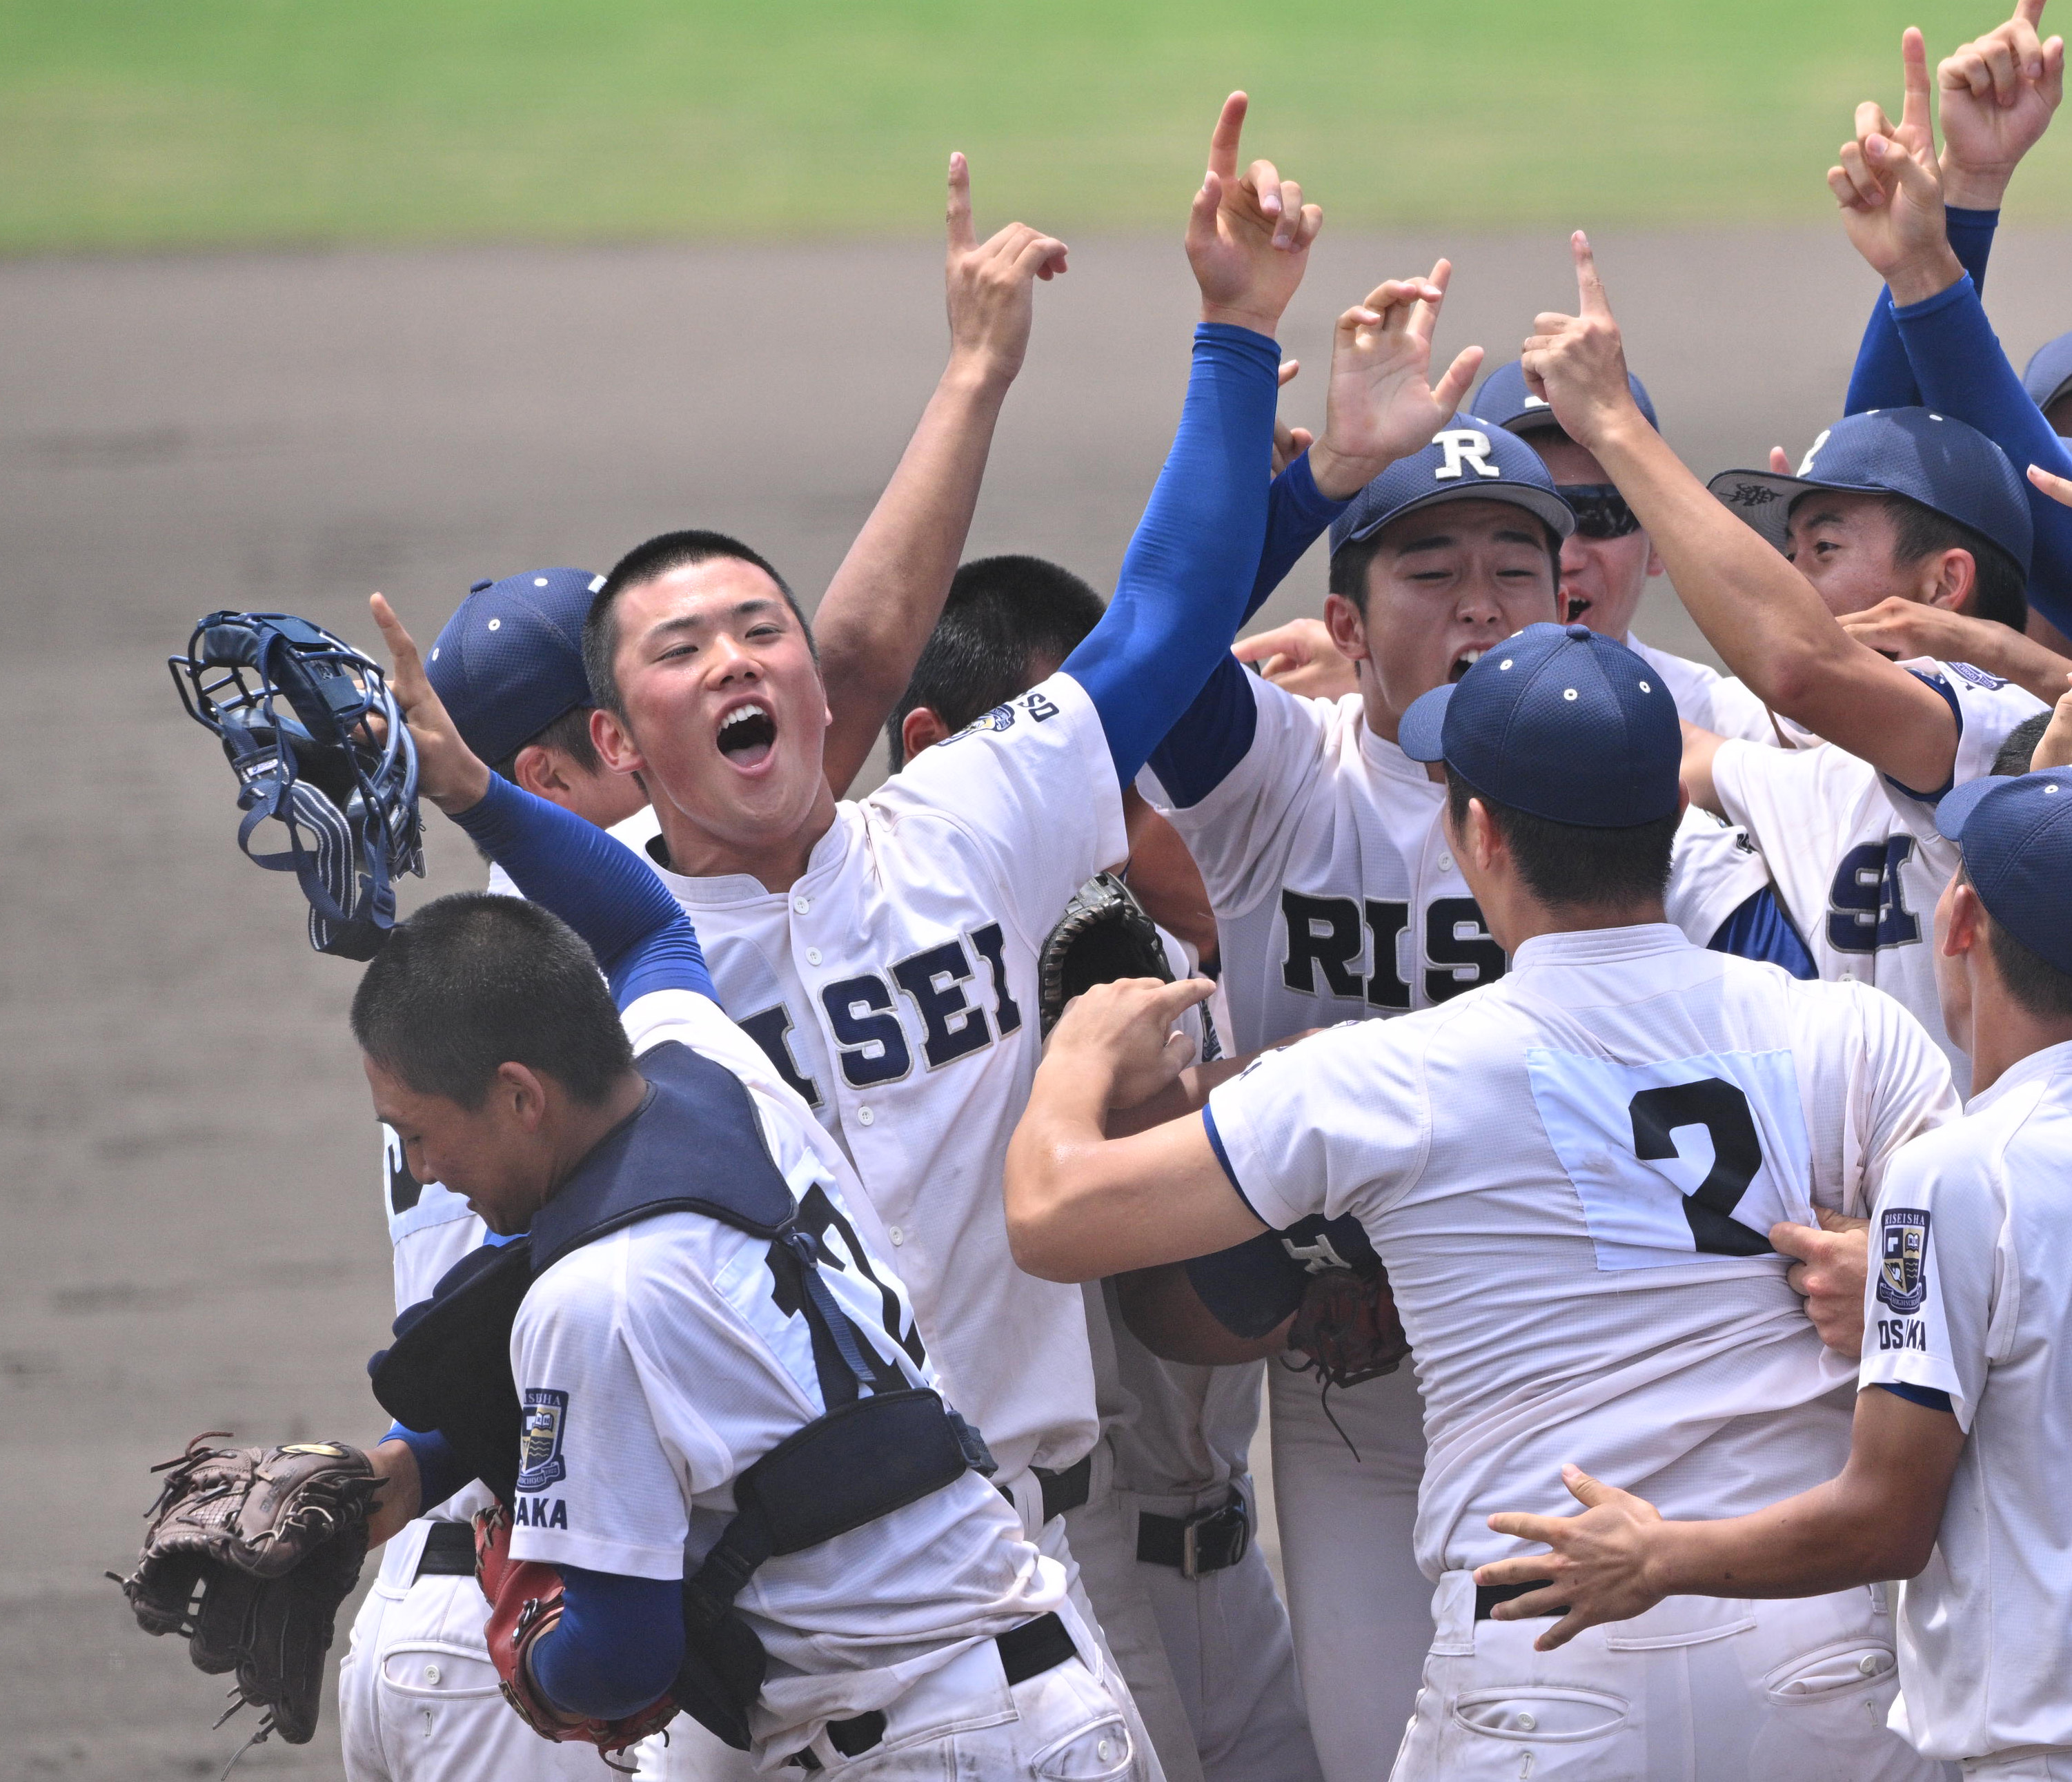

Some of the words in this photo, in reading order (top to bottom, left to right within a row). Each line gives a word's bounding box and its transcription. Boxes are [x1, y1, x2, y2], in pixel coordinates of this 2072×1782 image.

[1432, 429, 1499, 480] R
[1628, 1077, 1775, 1256] 2
[1884, 1213, 1925, 1226] RISEISHA
[1877, 1318, 1926, 1351] OSKA
[515, 1496, 568, 1530] AKA
